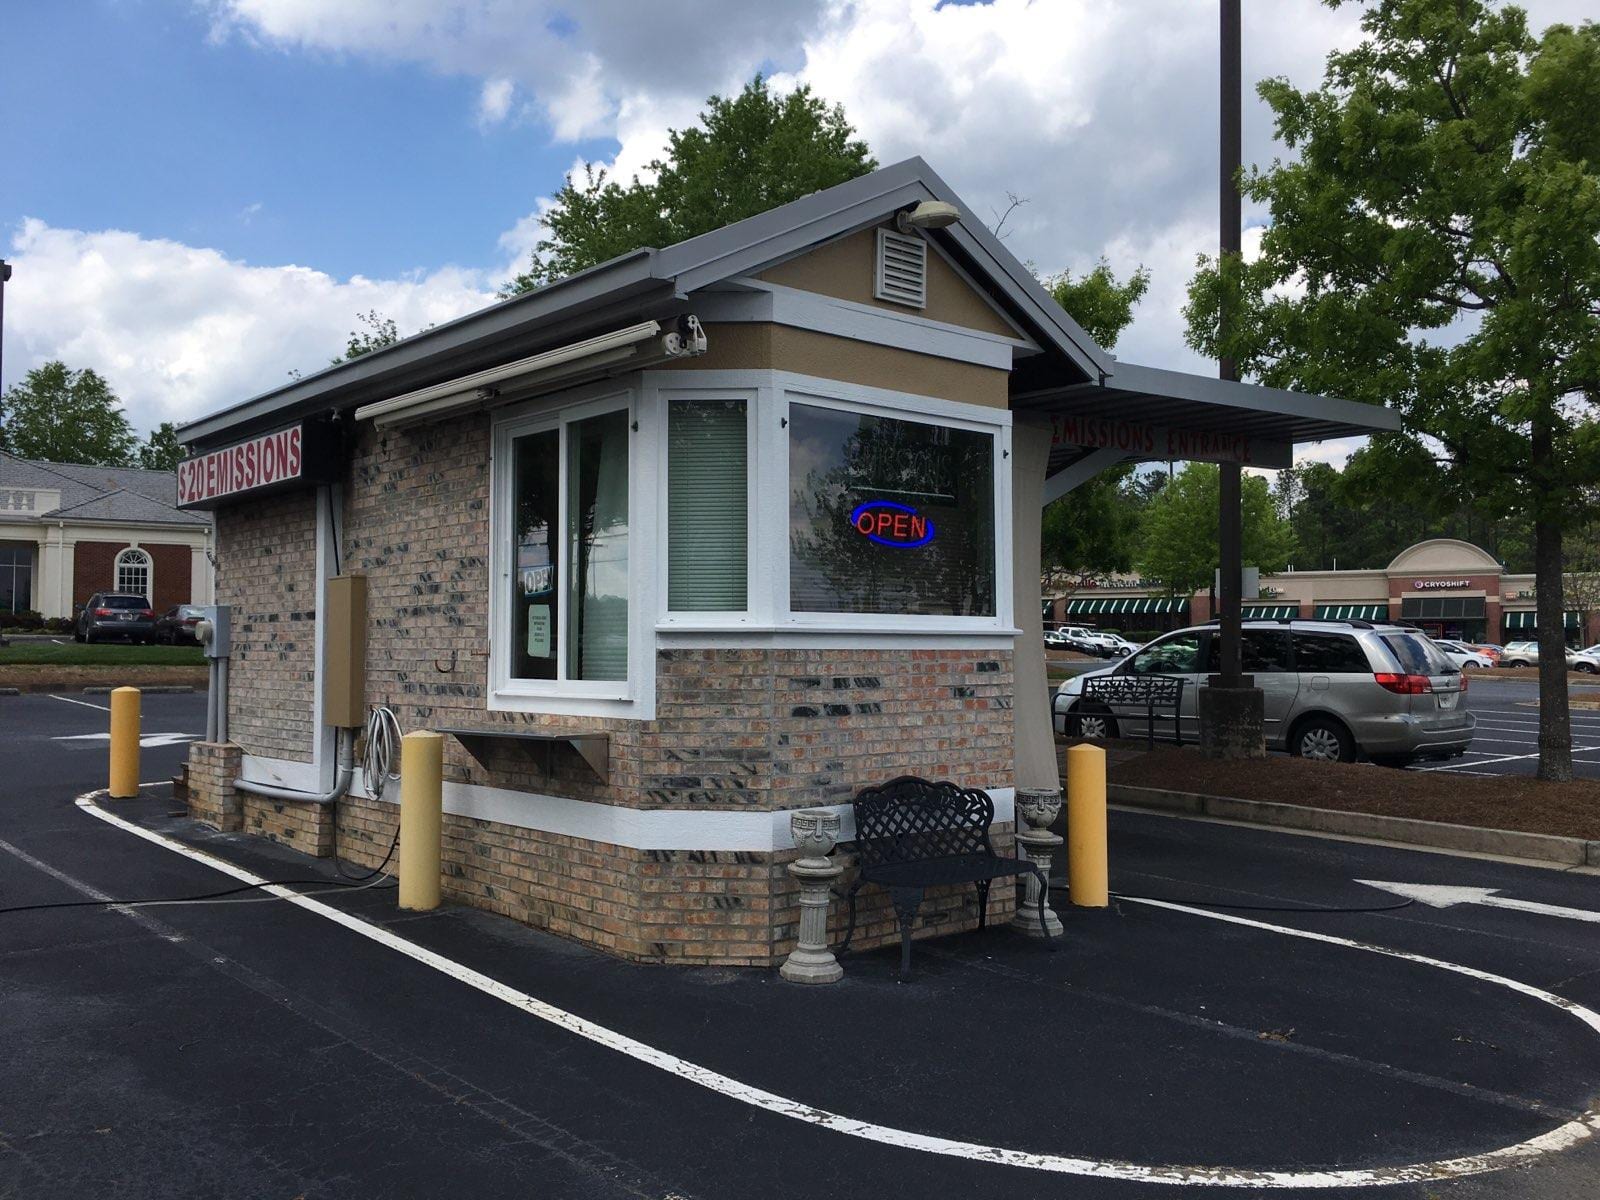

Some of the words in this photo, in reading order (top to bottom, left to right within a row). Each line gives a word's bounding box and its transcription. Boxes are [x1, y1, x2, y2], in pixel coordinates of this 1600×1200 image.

[1050, 414, 1154, 453] EMISSIONS
[1167, 428, 1252, 463] ENTRANCE
[179, 458, 204, 502] $20
[206, 428, 300, 497] EMISSIONS
[857, 511, 926, 538] OPEN
[525, 565, 554, 594] OPEN
[1424, 580, 1470, 588] CRYOSHIFT
